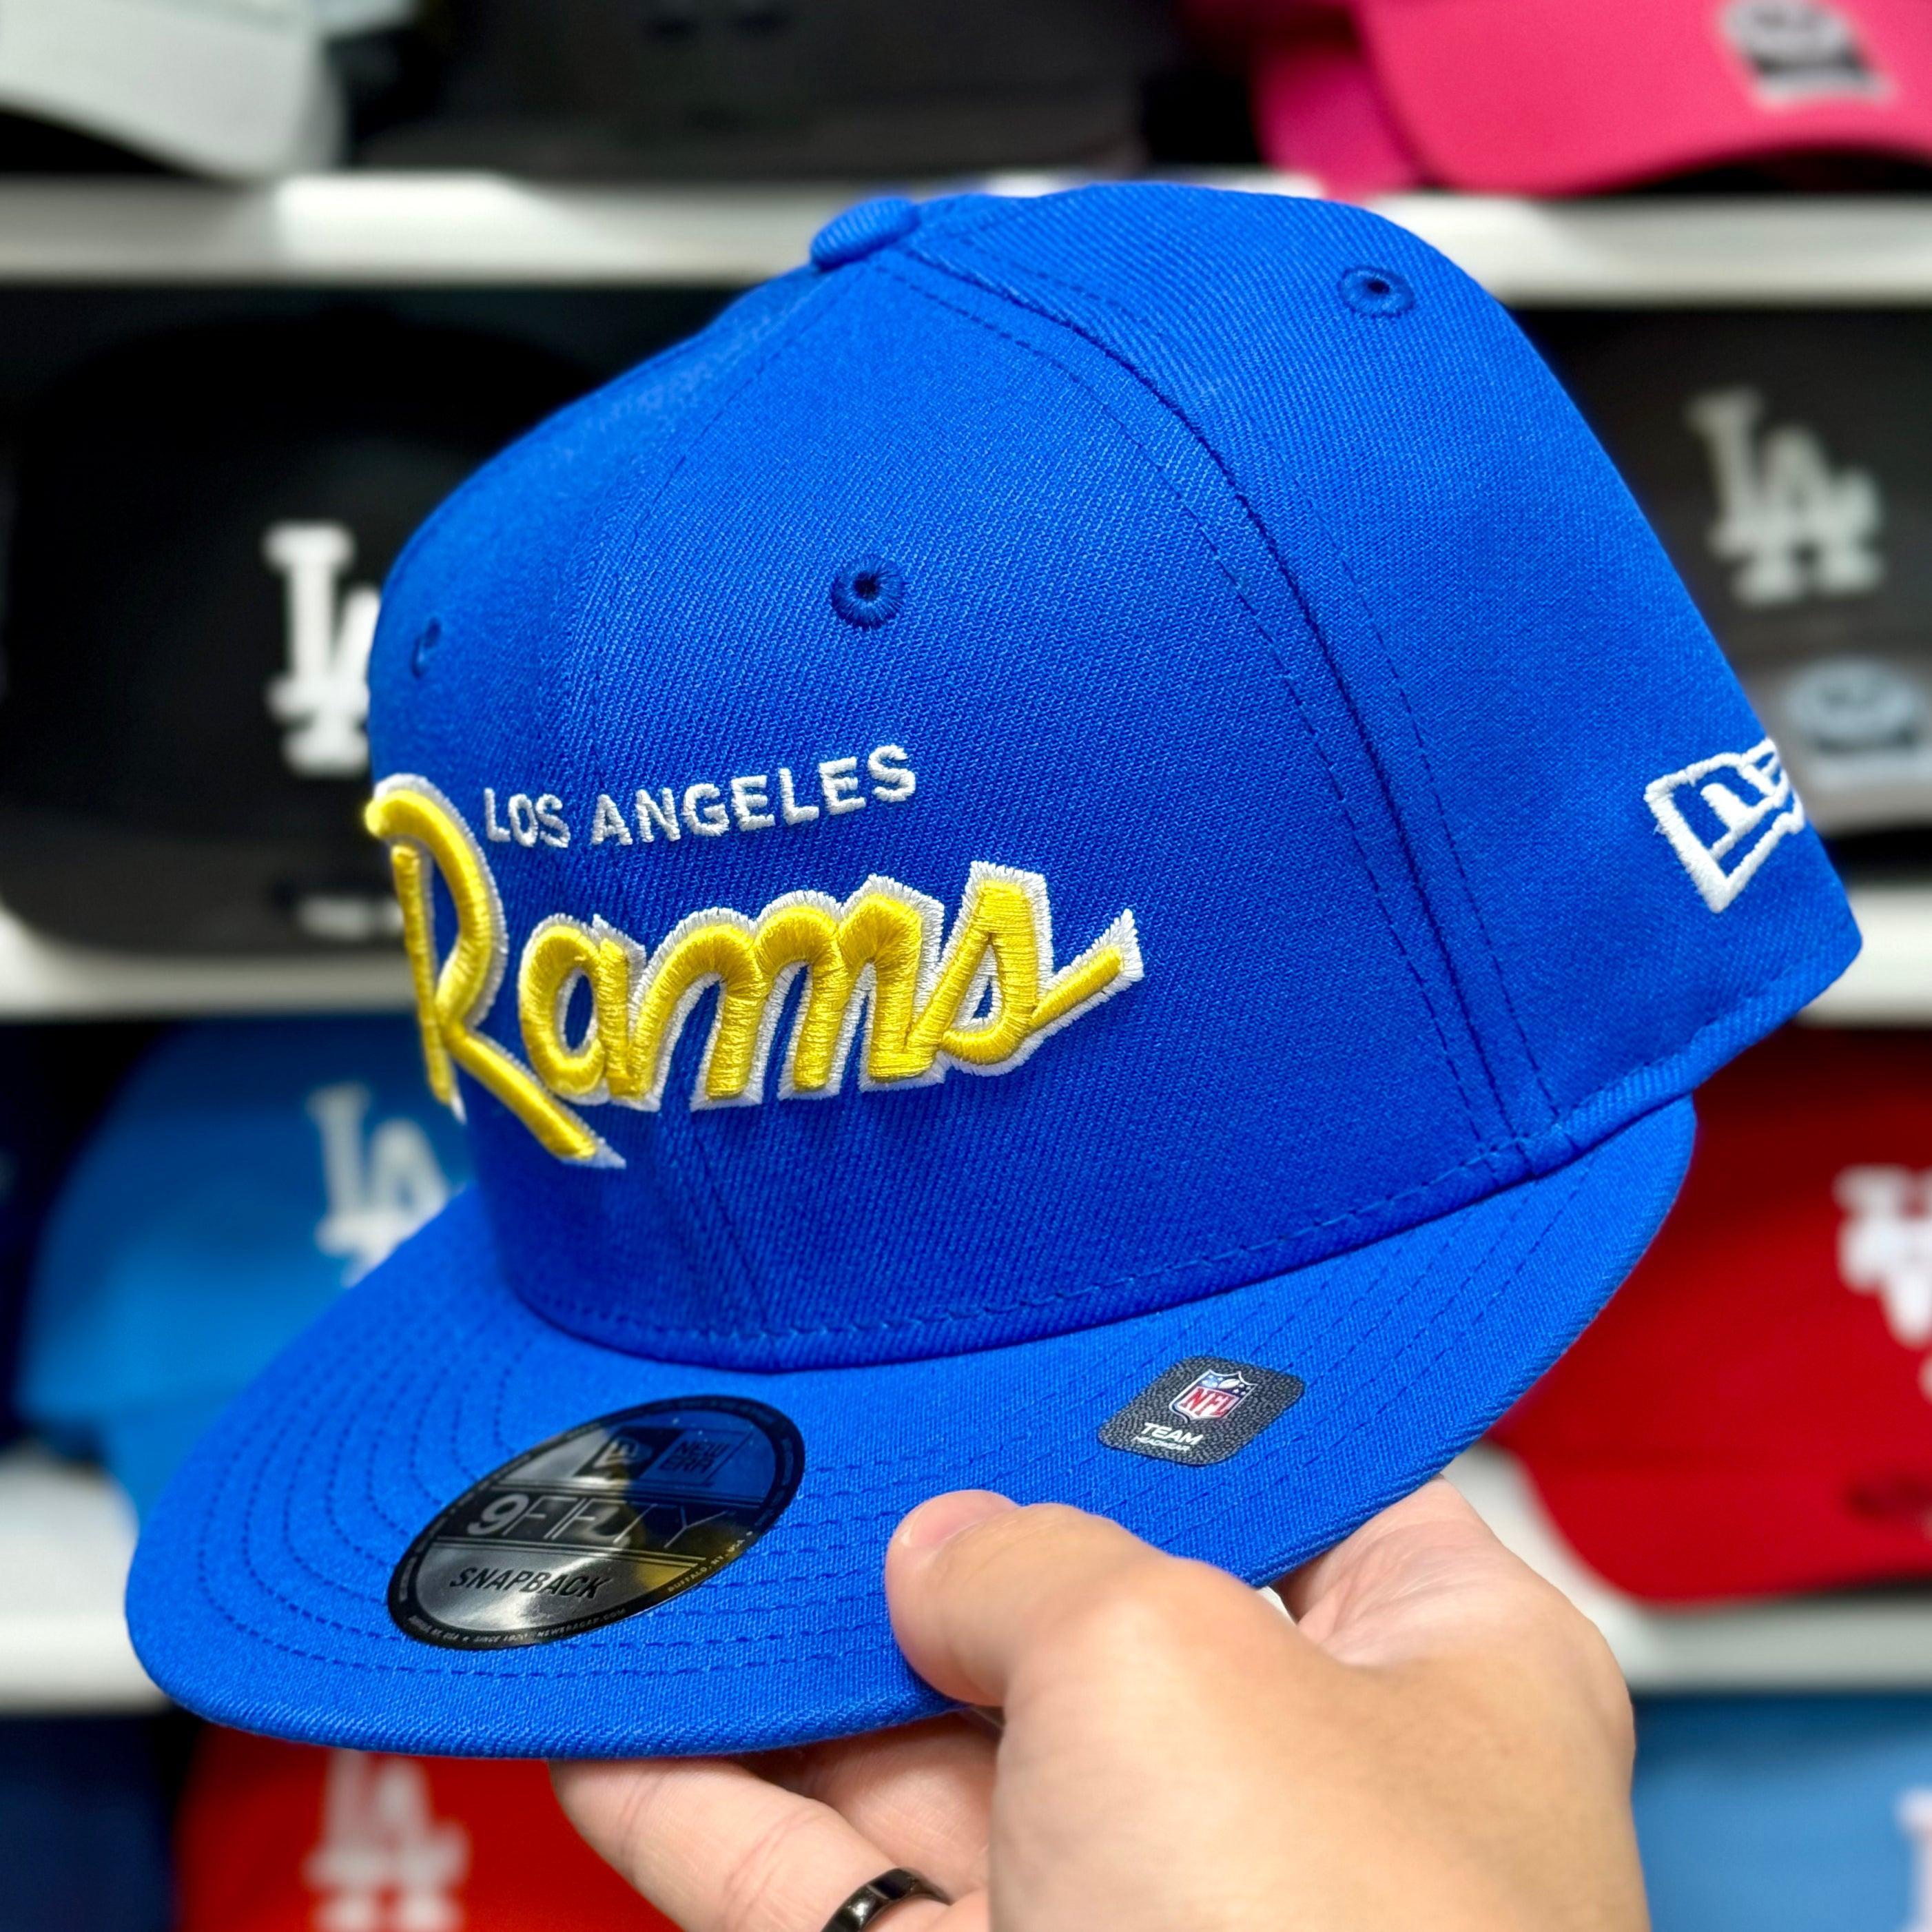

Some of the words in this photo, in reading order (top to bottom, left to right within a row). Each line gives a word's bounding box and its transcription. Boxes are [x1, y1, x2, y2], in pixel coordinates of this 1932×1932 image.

[1681, 386, 1885, 608] LA
[484, 787, 571, 848] LOS
[590, 743, 918, 847] ANGELES
[365, 772, 1144, 1169] Rams
[1178, 1387, 1238, 1418] NFL
[675, 1439, 731, 1457] NEW
[1140, 1421, 1204, 1445] TEAM
[659, 1455, 716, 1474] ERA
[449, 1567, 613, 1600] SNAPBACK
